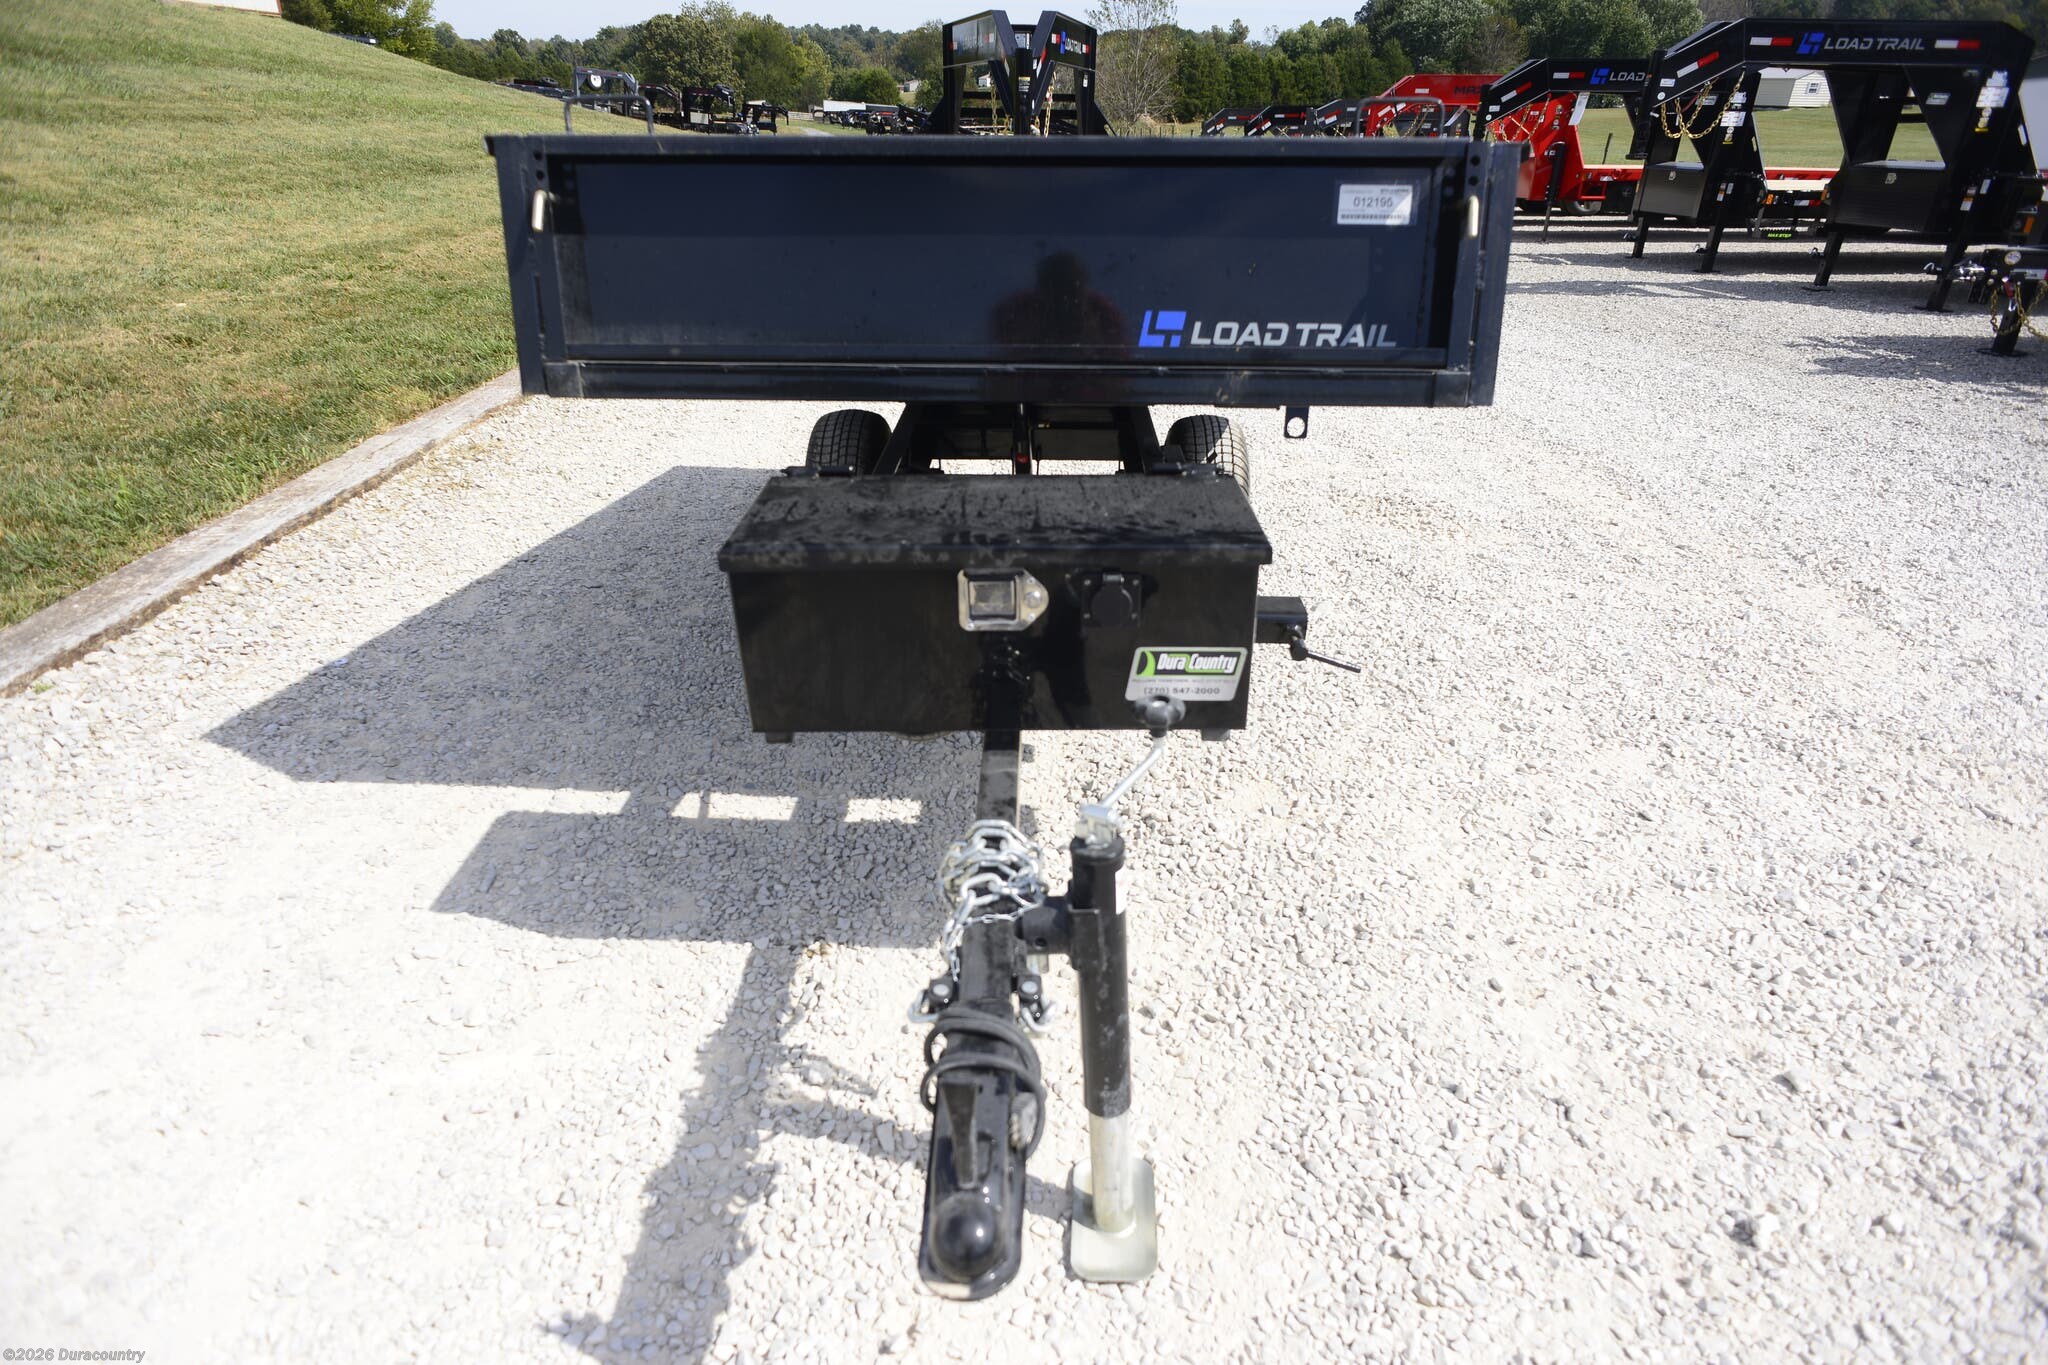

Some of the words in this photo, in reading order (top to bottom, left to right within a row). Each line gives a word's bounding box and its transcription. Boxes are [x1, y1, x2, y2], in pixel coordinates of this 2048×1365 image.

[1824, 37, 1872, 50] LOAD
[1876, 37, 1925, 50] TRAIL
[1610, 71, 1646, 81] LOAD
[1191, 321, 1290, 347] LOAD
[1296, 323, 1398, 348] TRAIL
[1157, 653, 1187, 671] Dura
[1189, 653, 1237, 674] Country
